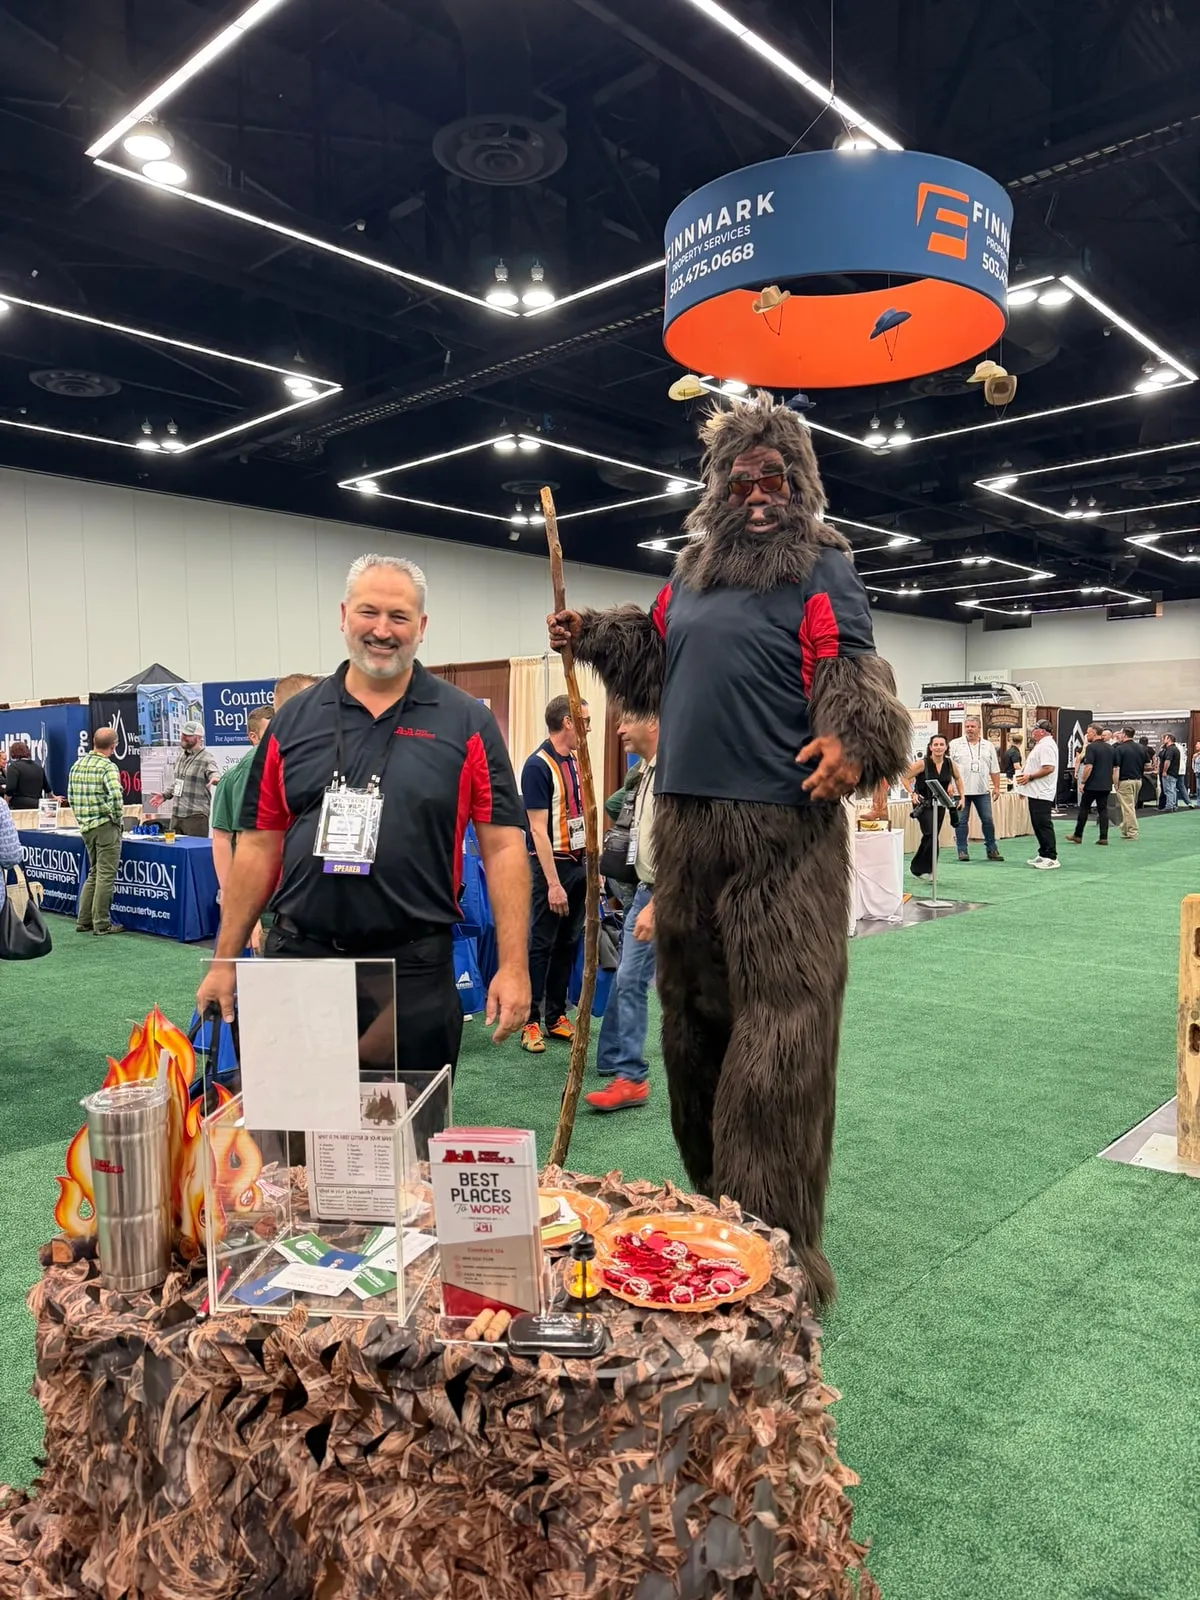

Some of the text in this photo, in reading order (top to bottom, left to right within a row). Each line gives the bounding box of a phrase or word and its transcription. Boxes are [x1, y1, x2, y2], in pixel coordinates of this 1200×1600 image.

[665, 190, 775, 269] FINNMARK
[972, 200, 1010, 254] FINN
[671, 224, 751, 275] PROPERTY SERVICES
[669, 242, 755, 299] 503.475.0668
[220, 688, 275, 706] Counte
[213, 707, 249, 731] Repl
[20, 845, 81, 883] PRECISION
[333, 864, 361, 873] SPEAKER
[26, 868, 76, 885] COUNTERTOPS
[459, 1172, 500, 1187] BEST
[450, 1187, 512, 1204] PLACES
[470, 1204, 511, 1215] WORK
